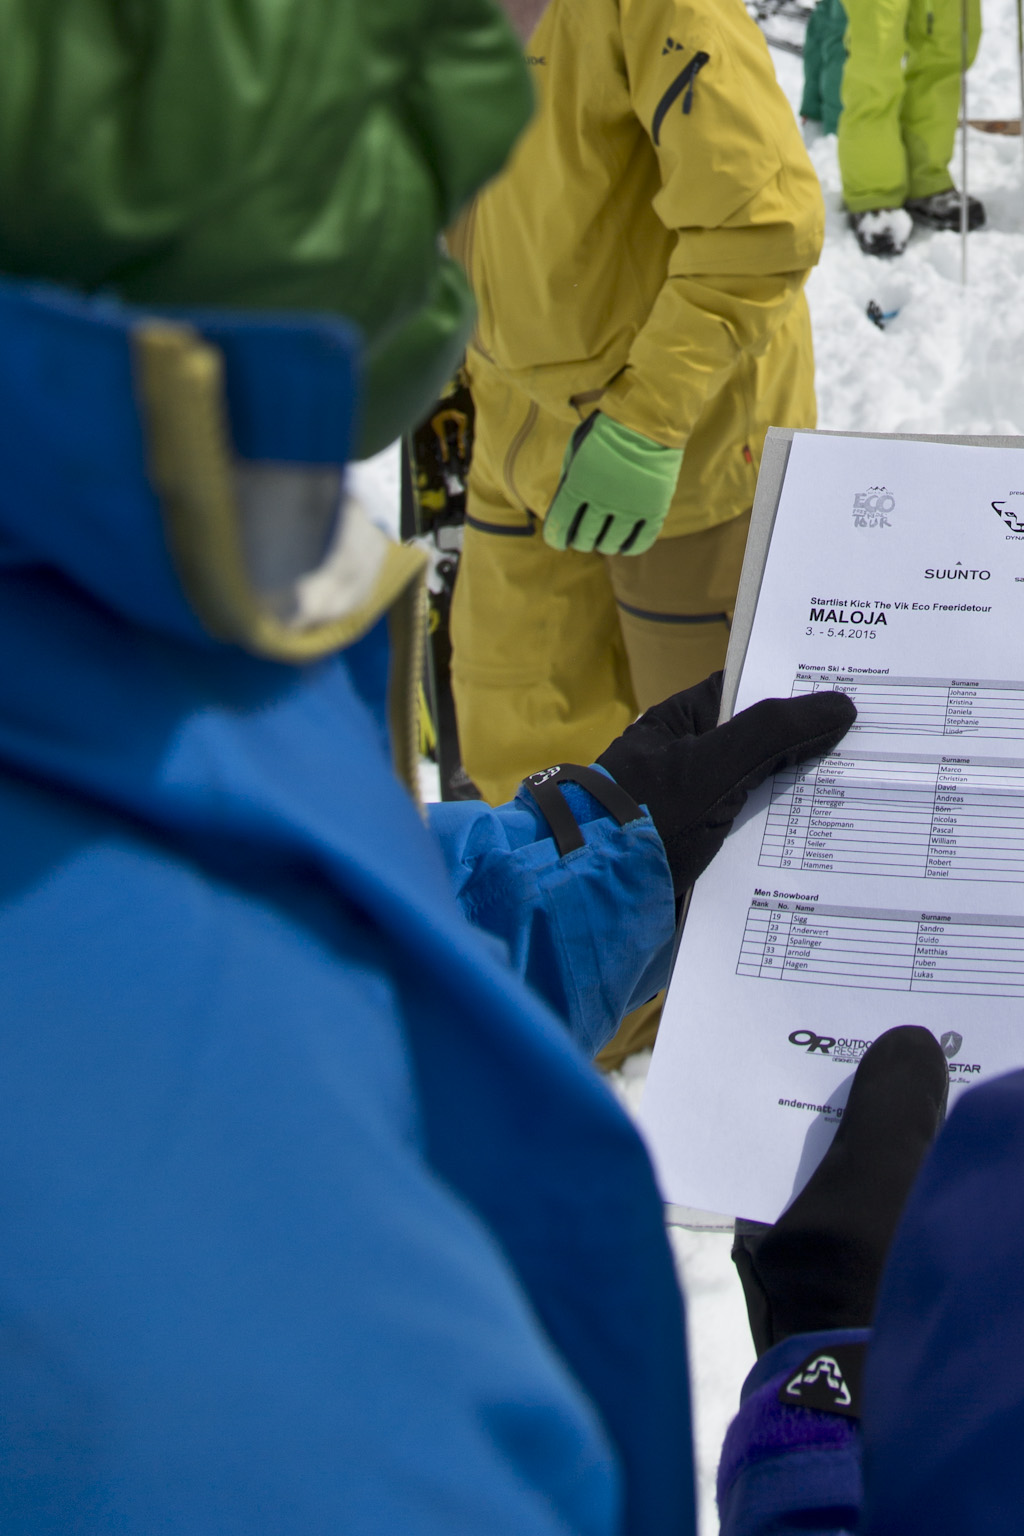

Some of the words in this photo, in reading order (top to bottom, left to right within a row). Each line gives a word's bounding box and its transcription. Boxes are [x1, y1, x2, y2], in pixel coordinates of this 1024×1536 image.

[853, 493, 895, 513] ECO
[924, 568, 991, 581] SUUNTO
[810, 597, 848, 607] Startlist
[850, 599, 871, 609] Kick
[874, 601, 892, 610] The
[894, 601, 910, 611] Vik
[911, 603, 930, 611] Eco
[932, 603, 992, 613] Freeridetour
[809, 608, 888, 626] MALOJA
[805, 626, 815, 637] 3.
[827, 628, 877, 640] 5.4.2015
[795, 673, 812, 681] Rank
[798, 664, 826, 672] Women
[847, 667, 890, 675] Snowboard
[835, 685, 858, 693] Bogner
[950, 689, 977, 697] Johanna
[946, 717, 979, 726] Stephanie
[821, 759, 855, 767] Tribelhorn
[940, 766, 962, 774] Marco
[815, 787, 845, 797] Schelling
[936, 794, 964, 803] Andreas
[937, 784, 957, 792] David
[814, 799, 845, 808] Heregger
[811, 808, 832, 817] forrer
[933, 816, 957, 824] nicolas
[790, 817, 799, 825] 22
[810, 819, 854, 829] Schoppmann
[932, 826, 954, 834] Pascal
[808, 830, 833, 838] Cochet
[931, 837, 957, 845] William
[786, 838, 795, 846] 35
[807, 840, 826, 848] Seiler
[930, 848, 957, 856] Thomas
[784, 848, 793, 856] 37
[805, 850, 834, 859] Weissen
[928, 858, 952, 866] Robert
[803, 861, 834, 870] Hammes
[927, 869, 949, 877] Daniel
[754, 888, 771, 897] Men
[773, 890, 819, 902] Snowboard
[751, 900, 769, 908] Rank
[795, 904, 815, 912] Name
[921, 914, 952, 922] Surname
[771, 913, 782, 921] 19
[793, 915, 808, 924] Sigg
[919, 924, 945, 933] Sandro
[770, 924, 779, 932] 23
[791, 926, 829, 936] Anderwert
[918, 936, 940, 944] Guido
[789, 937, 822, 947] Spalinger
[916, 947, 948, 956] Matthias
[766, 946, 775, 954] 33
[787, 949, 811, 957] arnold
[915, 959, 937, 967] ruben
[785, 960, 808, 970] Hagen
[913, 970, 934, 979] Lukas
[788, 1029, 837, 1054] OR
[837, 1038, 874, 1049] OUTDO
[833, 1046, 866, 1057] RESEA
[948, 1063, 981, 1073] STAR
[778, 1097, 843, 1118] andermatt-g
